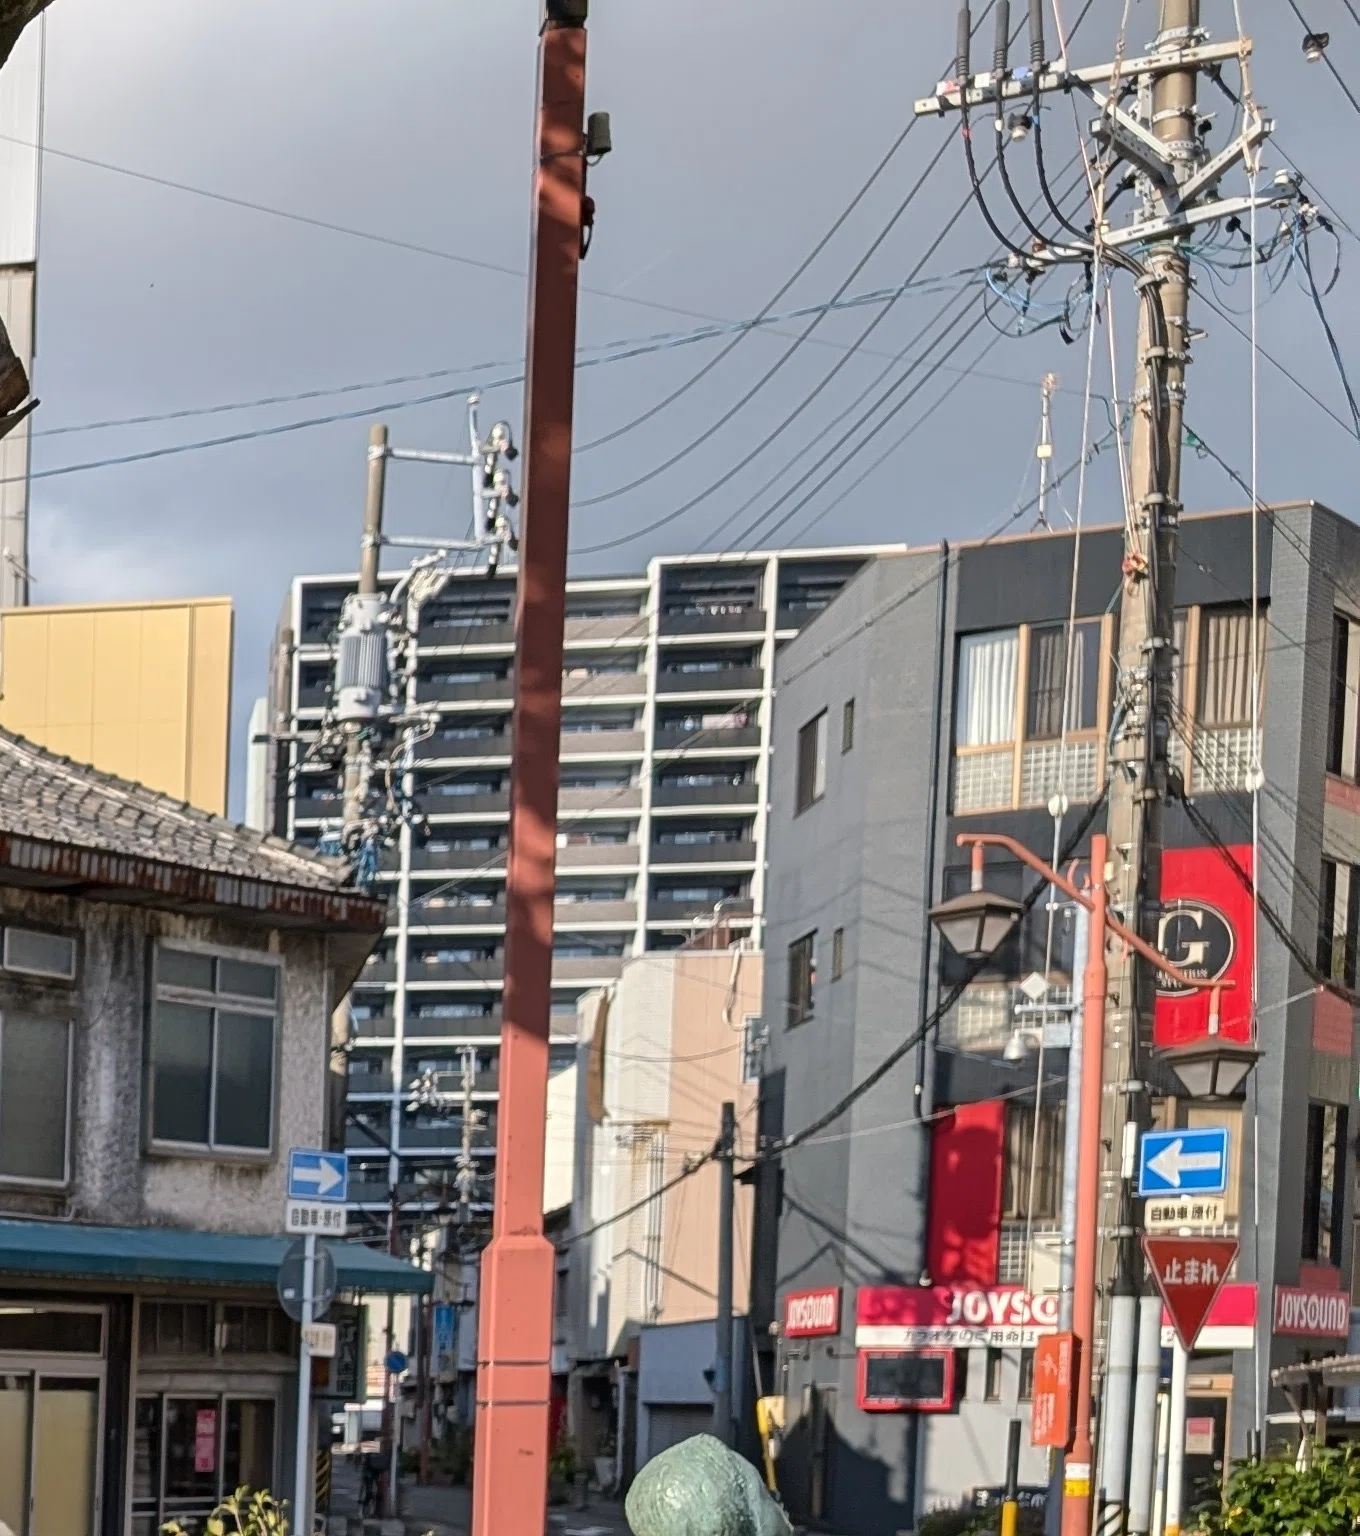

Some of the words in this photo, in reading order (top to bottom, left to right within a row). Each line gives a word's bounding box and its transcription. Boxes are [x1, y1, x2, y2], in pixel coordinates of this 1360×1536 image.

[1163, 1256, 1219, 1285] 止まれ
[945, 1290, 1058, 1325] JOYSO
[1278, 1292, 1346, 1331] JOYSOUND
